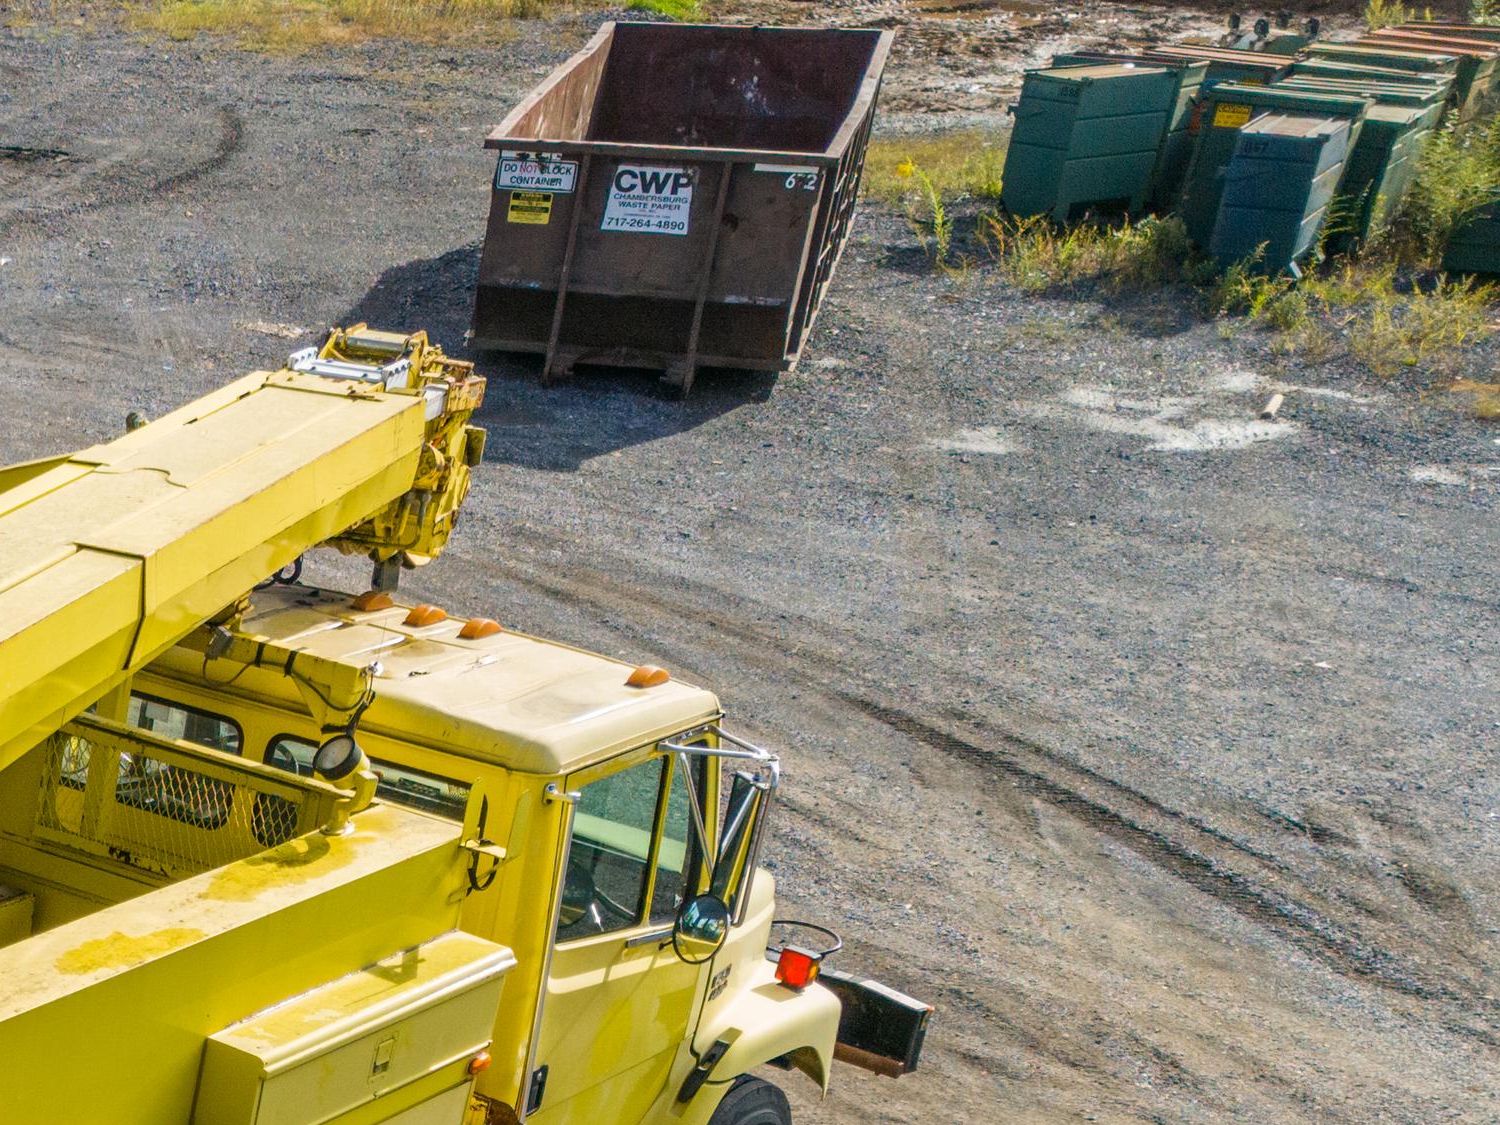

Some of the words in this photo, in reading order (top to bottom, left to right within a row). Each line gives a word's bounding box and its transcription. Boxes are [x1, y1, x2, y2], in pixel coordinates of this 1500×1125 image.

[504, 163, 518, 172] DO
[520, 161, 537, 173] NOT
[510, 176, 563, 186] CONTAINER
[614, 169, 692, 195] CWP
[613, 193, 688, 204] CHAMBERSBURG
[618, 201, 649, 209] WASTE
[607, 217, 685, 230] 717-264-4890
